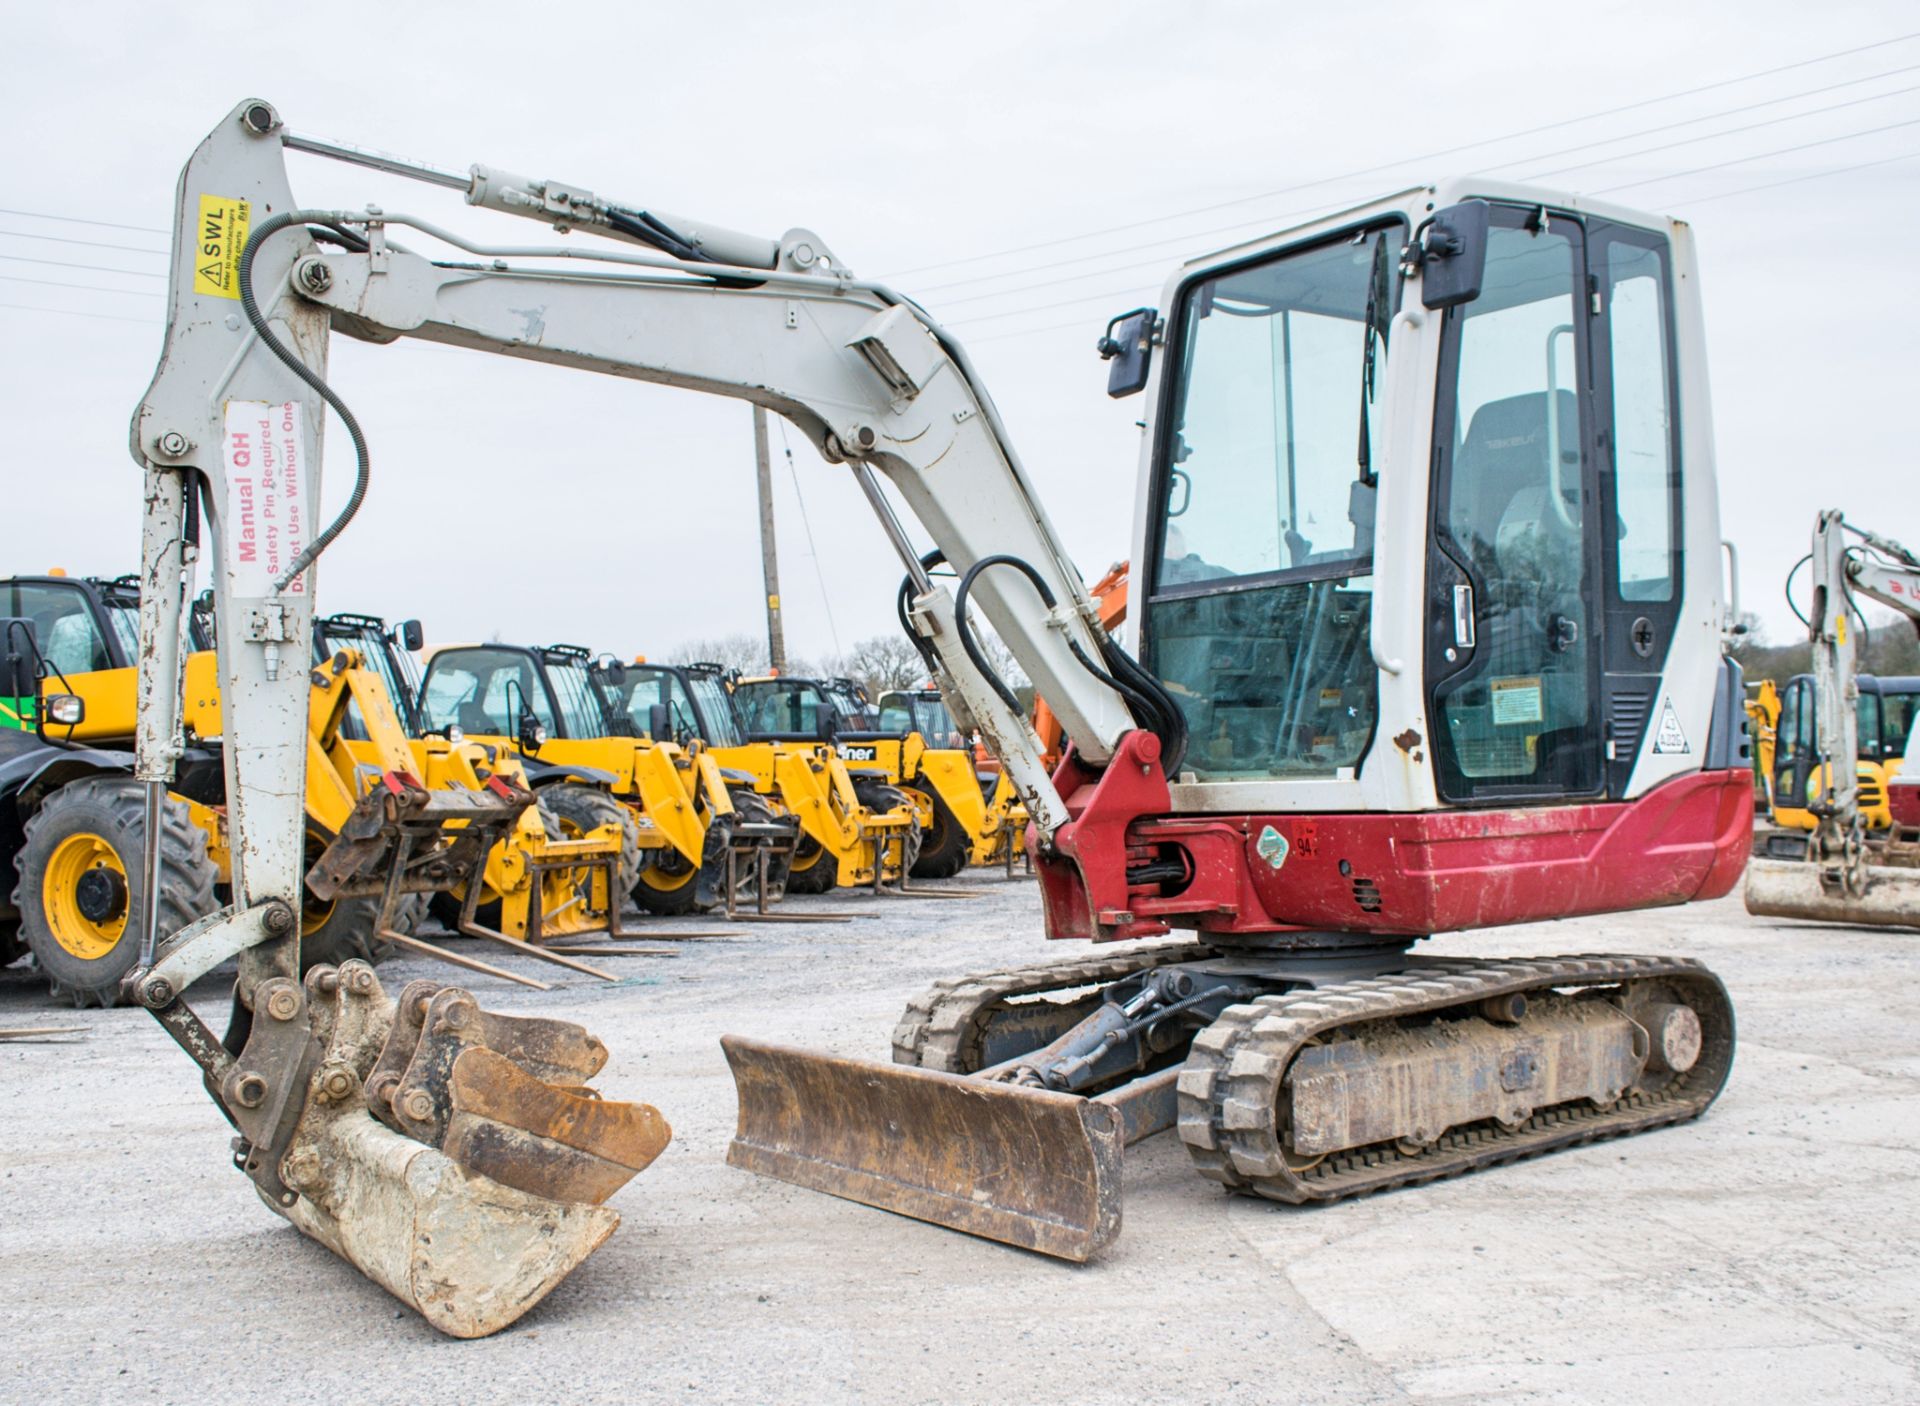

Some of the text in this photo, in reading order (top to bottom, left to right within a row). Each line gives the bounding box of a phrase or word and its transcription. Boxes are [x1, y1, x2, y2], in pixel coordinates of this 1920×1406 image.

[203, 208, 223, 257] SWL
[281, 402, 294, 432] One
[283, 438, 297, 498] Without
[231, 432, 256, 562] Manual QH
[258, 420, 280, 574] Safety Pin Required
[287, 505, 300, 534] Use
[291, 572, 303, 592] Do
